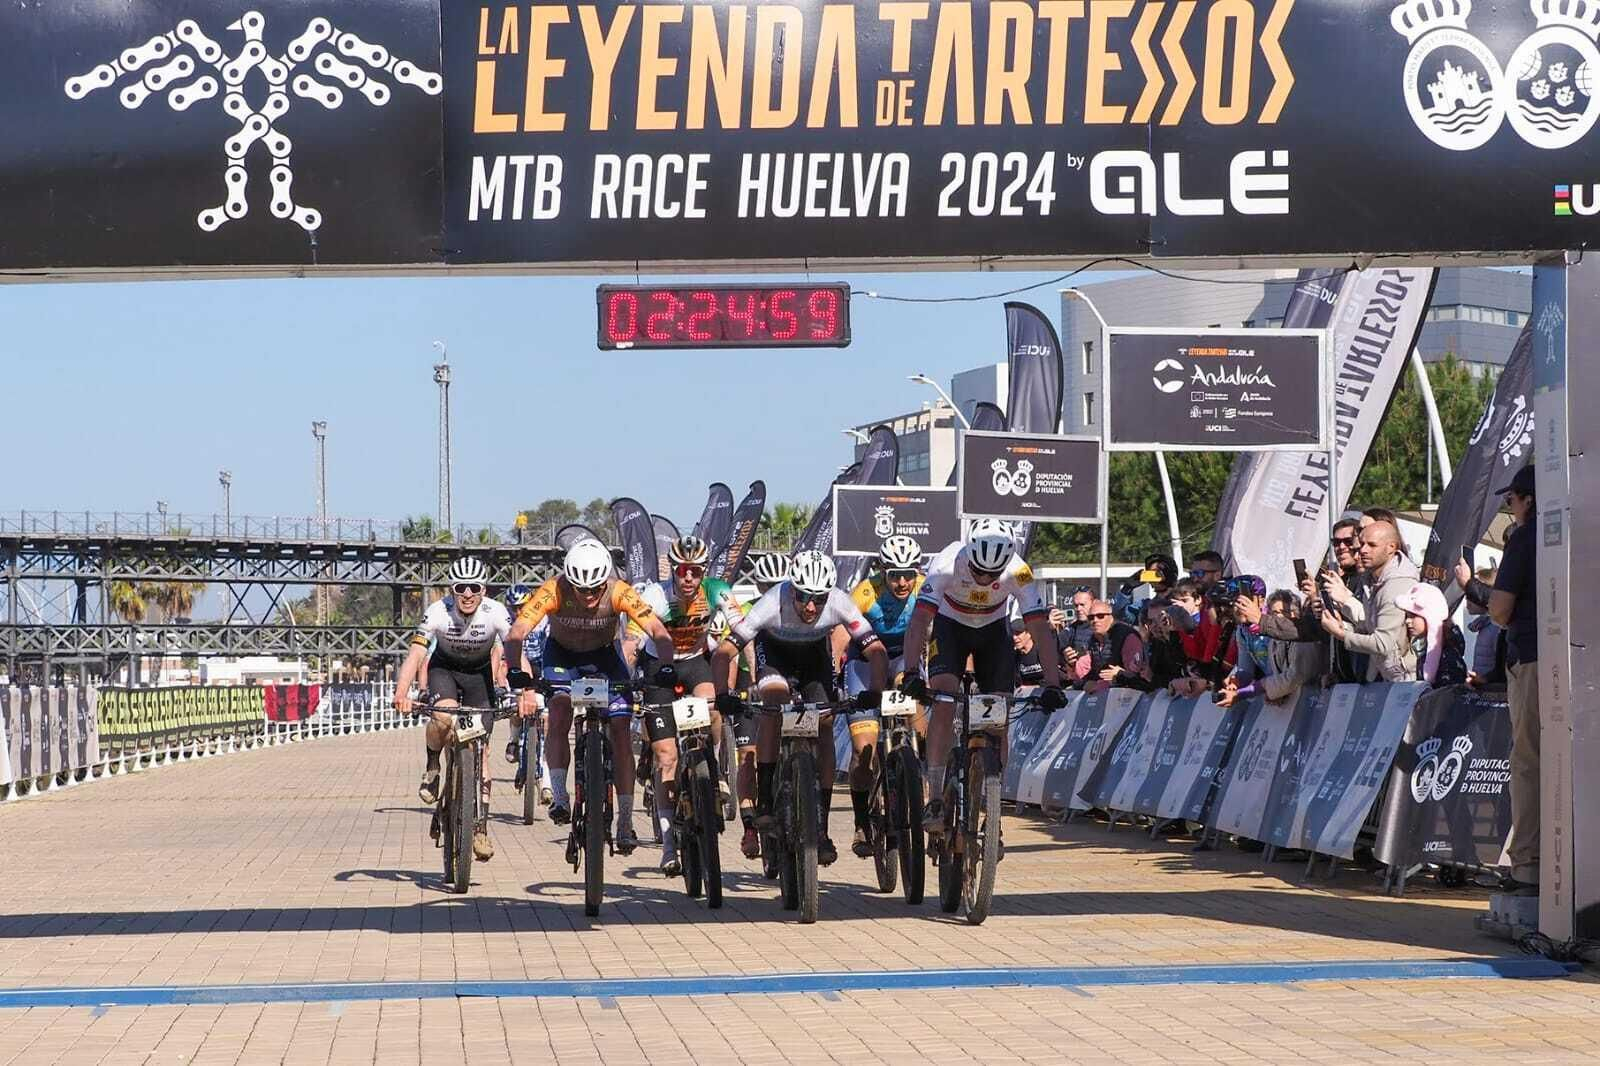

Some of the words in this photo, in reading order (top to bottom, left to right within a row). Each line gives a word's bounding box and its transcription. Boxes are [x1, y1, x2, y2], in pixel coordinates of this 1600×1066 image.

[478, 6, 519, 55] LA
[473, 2, 859, 133] LEYENDA
[879, 0, 1295, 126] TARTESSOS
[875, 79, 916, 127] DE
[468, 154, 564, 221] MTB
[590, 153, 711, 220] RACE
[737, 152, 910, 219] HUELVA
[938, 151, 1056, 217] 2024
[1067, 153, 1085, 170] by
[607, 290, 837, 341] 02:24:59
[1190, 364, 1276, 388] Andalucía
[896, 527, 930, 535] HUELVA
[583, 686, 595, 696] 9
[459, 716, 475, 731] 88
[686, 705, 695, 718] 3
[982, 705, 994, 718] 2
[1468, 783, 1503, 794] HUELVA
